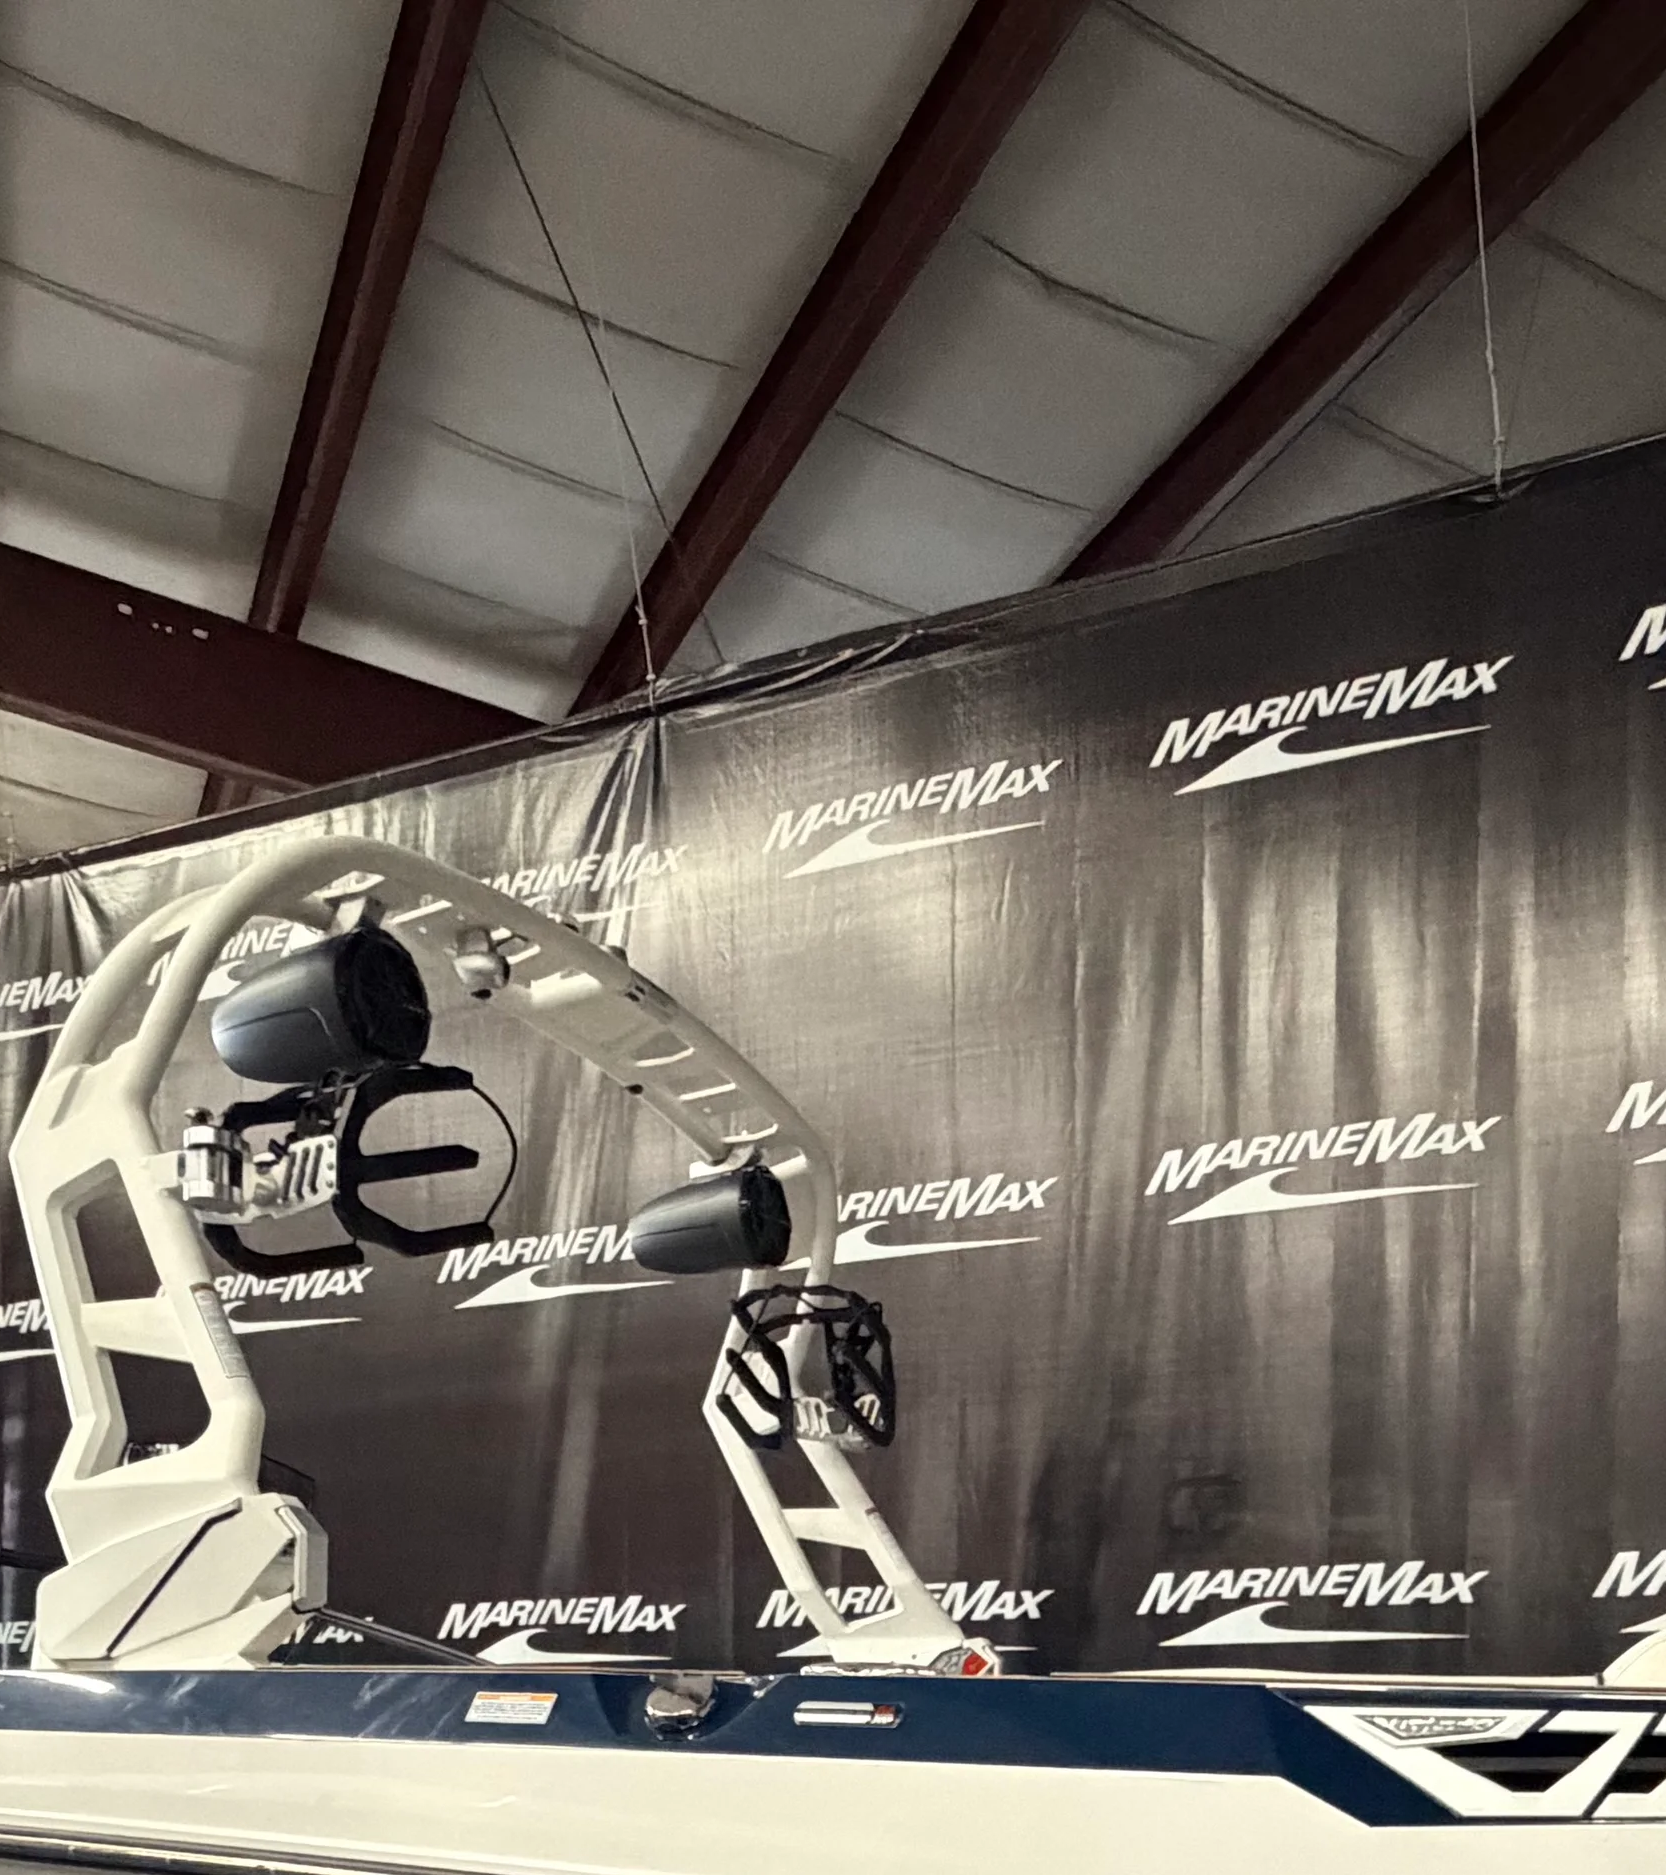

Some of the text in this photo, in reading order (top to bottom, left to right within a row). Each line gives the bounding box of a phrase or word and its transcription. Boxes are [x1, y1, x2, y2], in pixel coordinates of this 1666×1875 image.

[481, 840, 688, 898] ARINEMAX
[837, 1172, 1059, 1222] RINEMAX
[438, 1223, 636, 1284] MARINEM
[213, 1266, 374, 1303] RINEMAX
